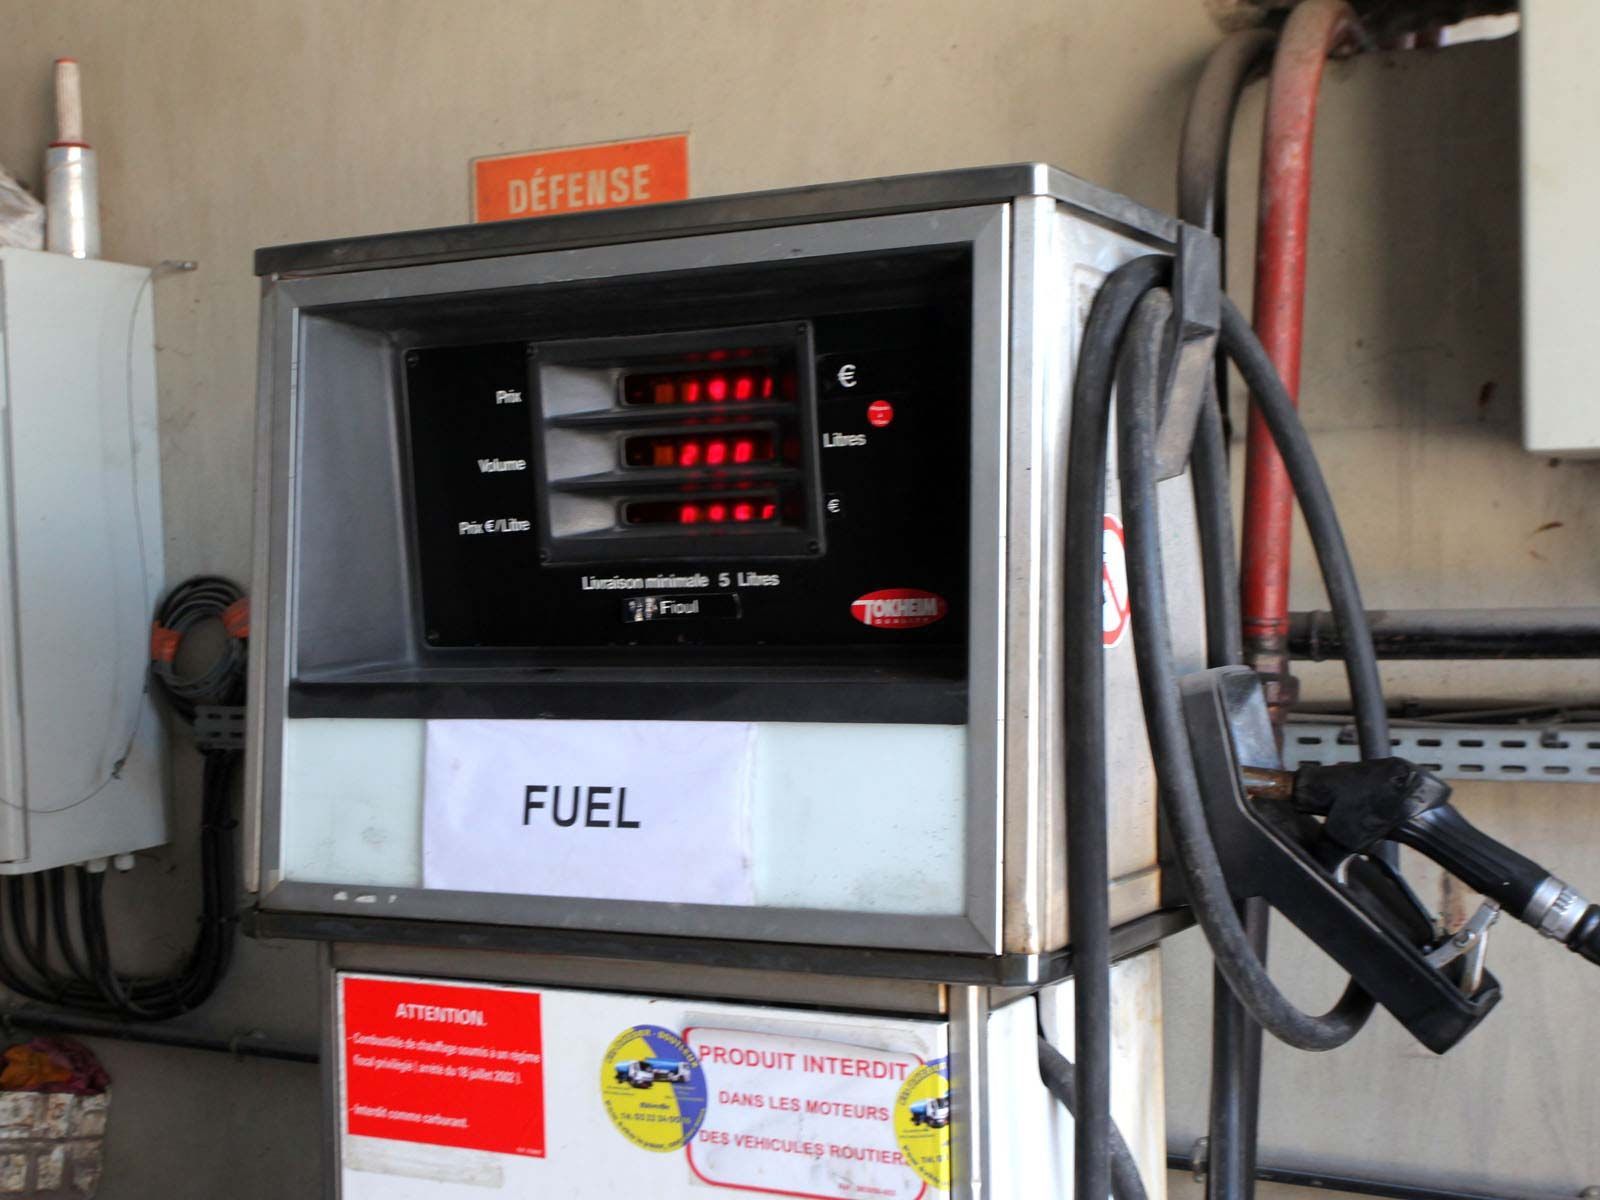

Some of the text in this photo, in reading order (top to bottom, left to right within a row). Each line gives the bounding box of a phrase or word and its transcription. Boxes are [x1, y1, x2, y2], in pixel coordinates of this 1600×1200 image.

[508, 165, 651, 214] DÉFENSE
[837, 364, 857, 388] €
[495, 389, 522, 404] Prix
[822, 432, 868, 448] Litres
[477, 458, 527, 473] Volume
[458, 520, 484, 535] Prix
[581, 572, 780, 590] Livraison minimale 5 Litres
[659, 600, 699, 615] Fioul
[522, 785, 640, 828] FUEL
[699, 1045, 796, 1071] PRODUIT
[803, 1054, 910, 1081] INTERDIT
[718, 1091, 765, 1109] DANS
[769, 1095, 800, 1112] LES
[805, 1100, 890, 1122] MOTEURS
[699, 1129, 730, 1146] DES
[734, 1134, 825, 1157] VEHICULES
